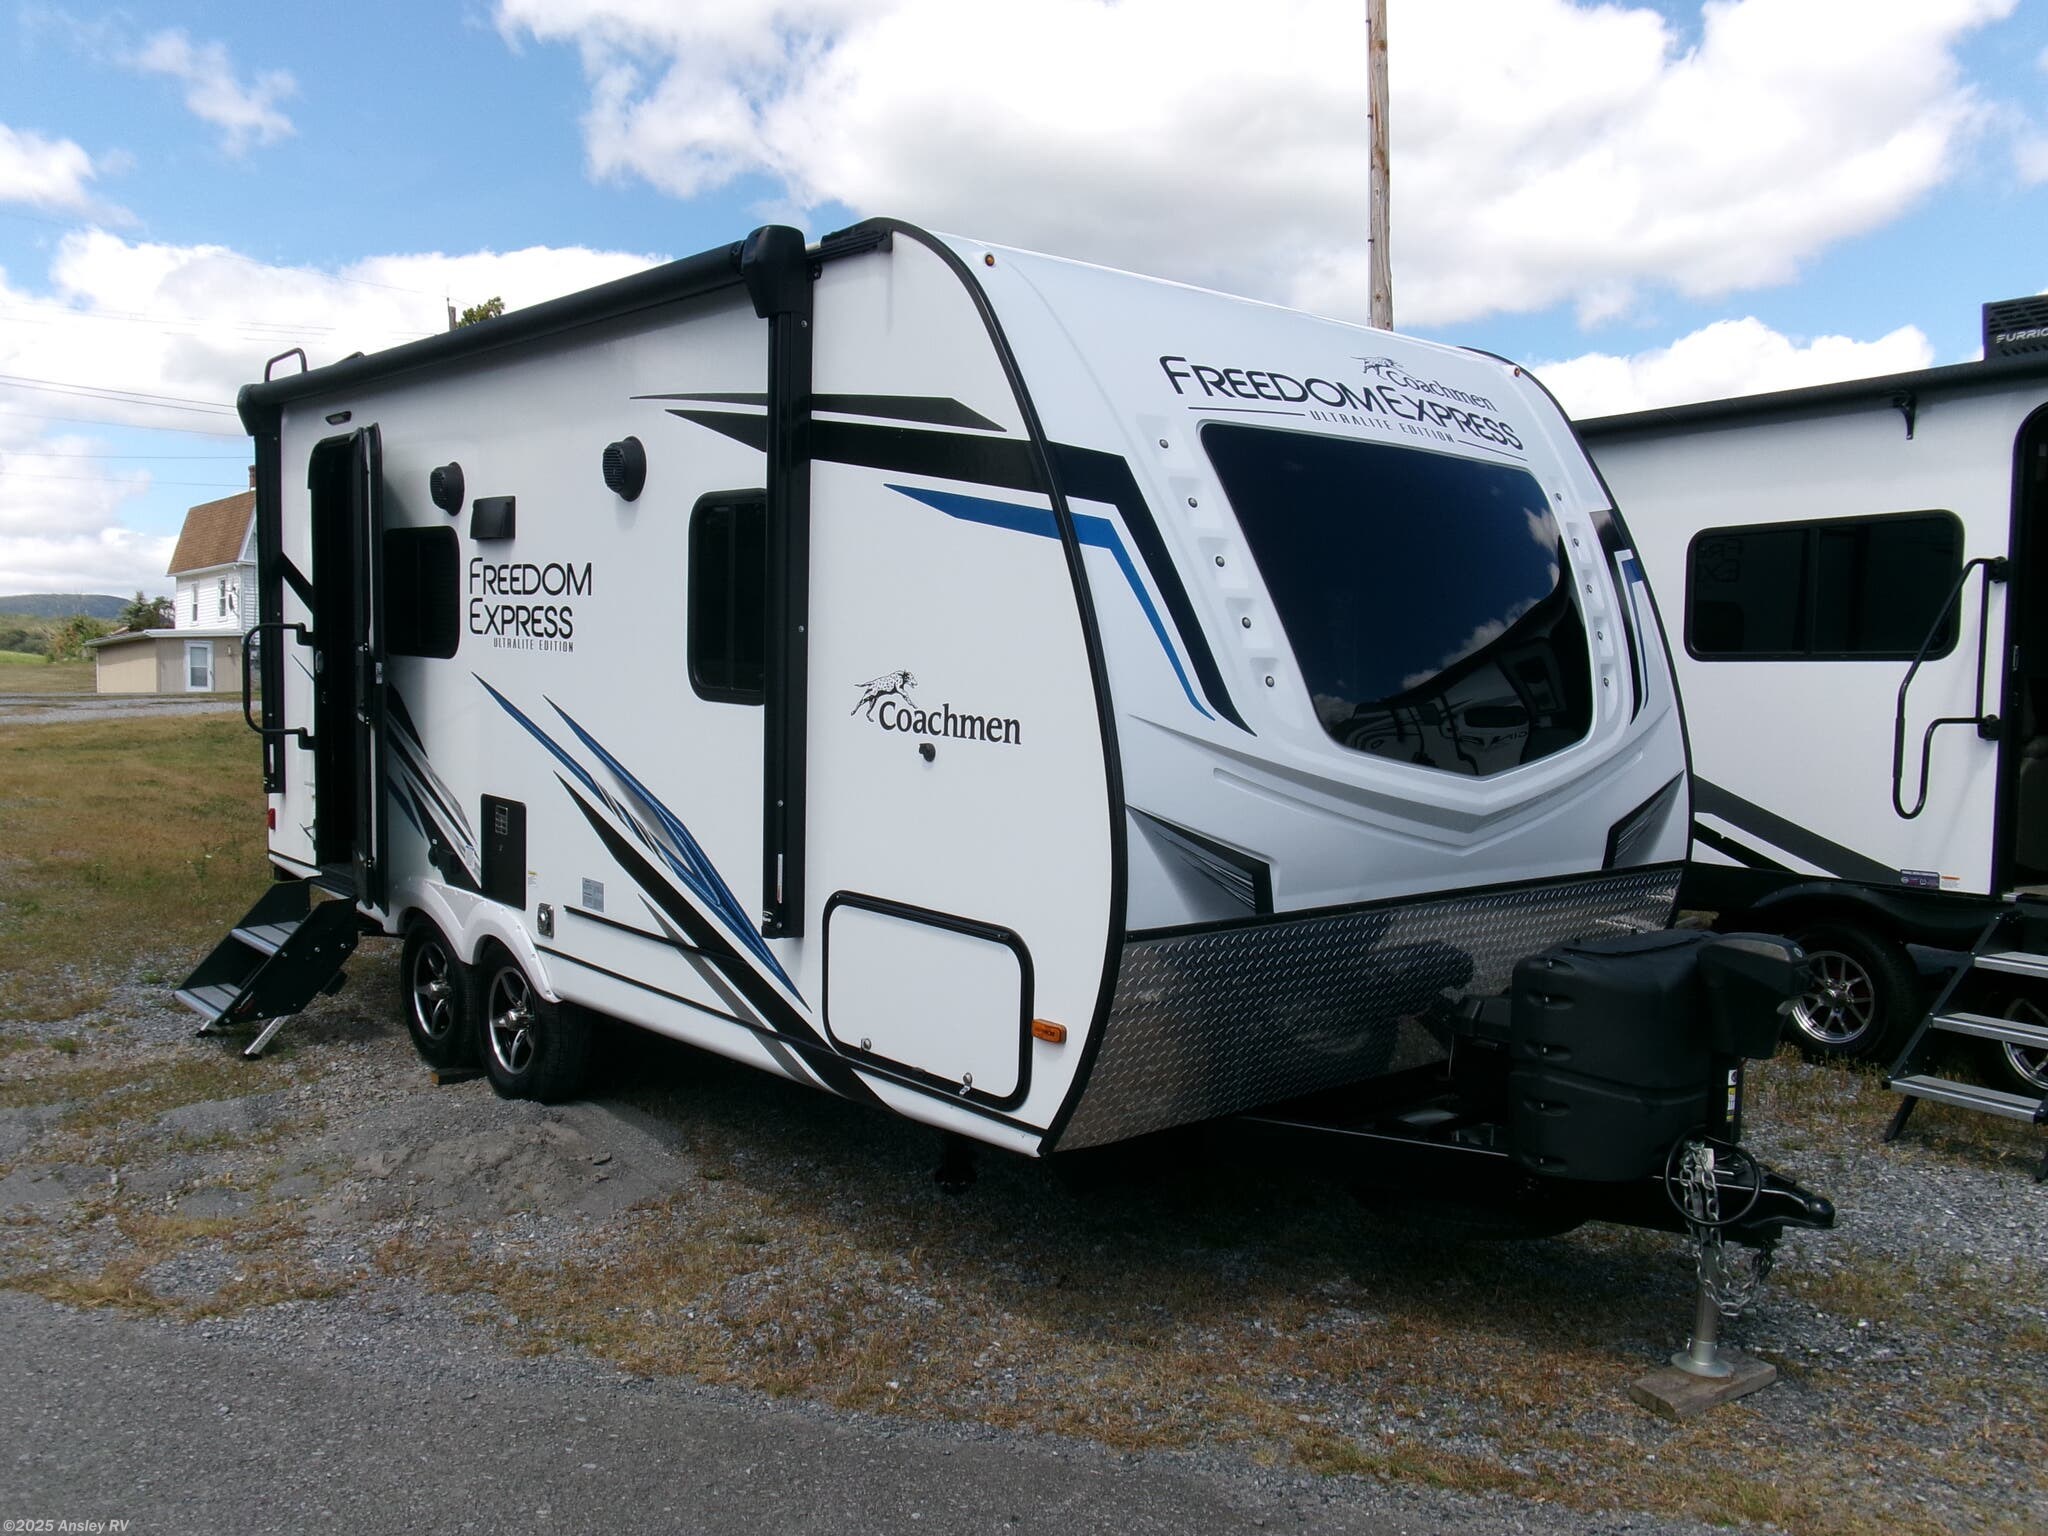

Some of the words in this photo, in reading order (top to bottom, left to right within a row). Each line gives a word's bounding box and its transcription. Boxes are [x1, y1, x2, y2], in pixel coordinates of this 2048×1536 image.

[1385, 370, 1499, 413] Coachmen
[1309, 410, 1393, 431] ULTRALITE
[1399, 422, 1455, 443] EDITION
[469, 557, 592, 596] FREEDOM
[469, 597, 574, 639] EXPRESS
[493, 637, 534, 651] ULTRALITE
[538, 639, 574, 653] EDITION
[878, 700, 1022, 745] Coachmen
